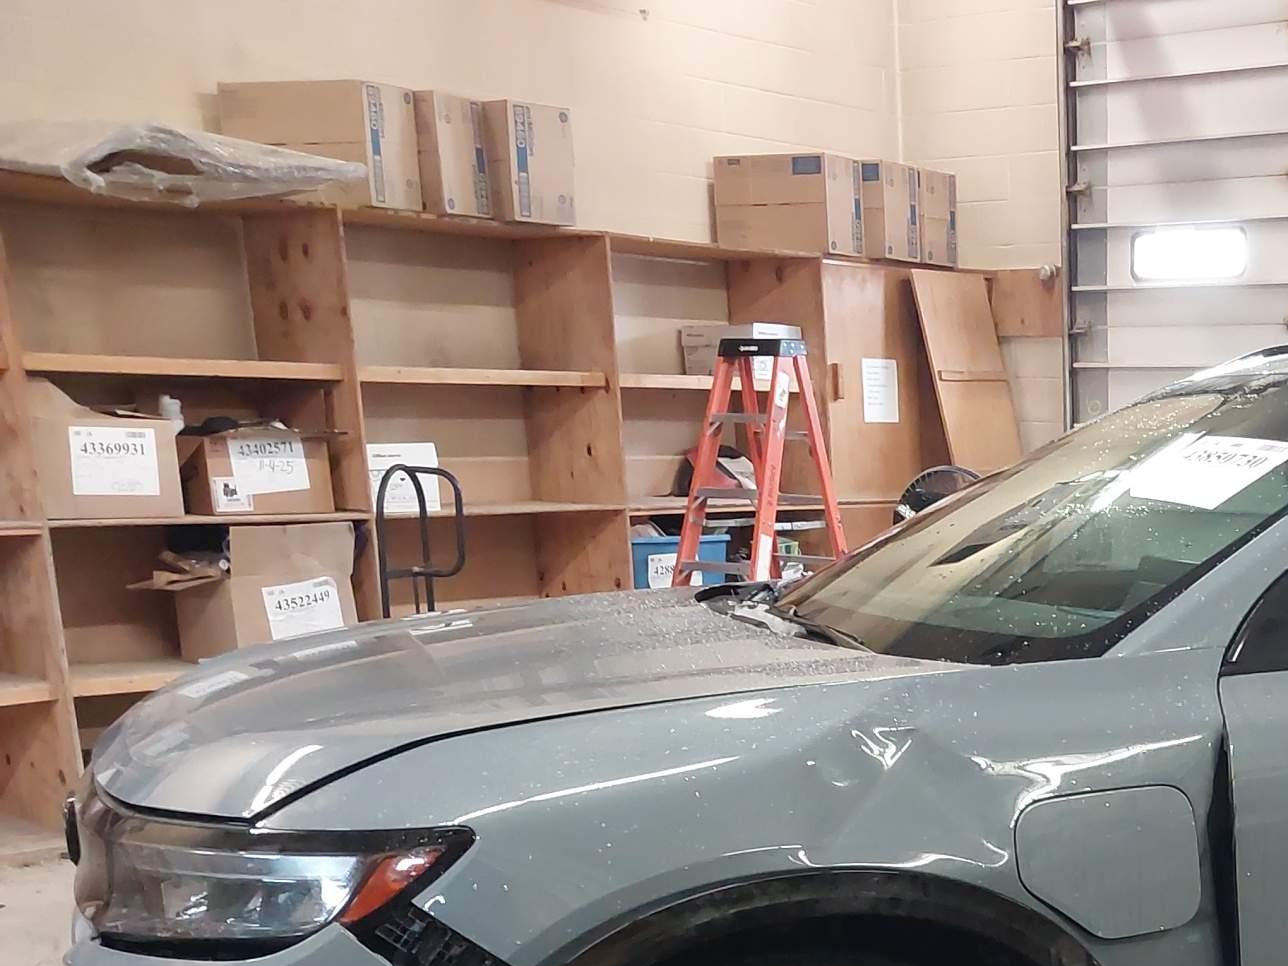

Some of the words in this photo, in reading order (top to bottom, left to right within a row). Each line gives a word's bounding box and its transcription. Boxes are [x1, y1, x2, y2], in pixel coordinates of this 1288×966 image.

[80, 441, 145, 456] 43369931
[238, 440, 294, 456] 43402571
[275, 589, 330, 611] 43522449
